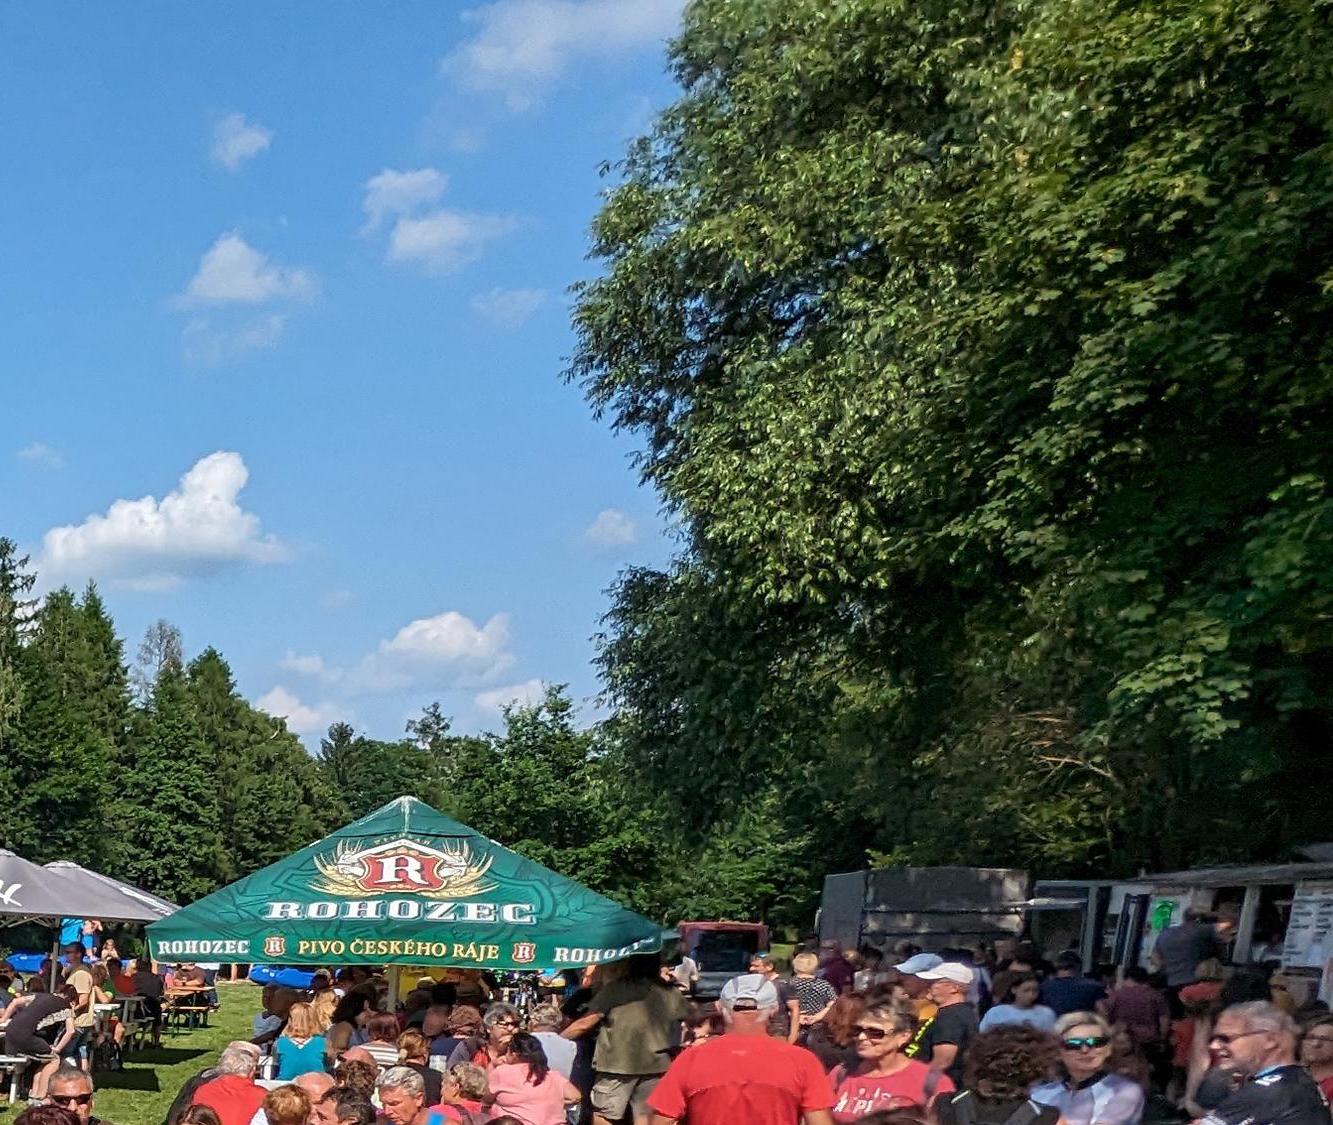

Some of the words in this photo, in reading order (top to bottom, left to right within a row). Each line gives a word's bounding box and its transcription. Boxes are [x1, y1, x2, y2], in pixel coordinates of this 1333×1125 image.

[374, 856, 429, 885] R
[266, 899, 536, 924] ROHOZEC
[157, 940, 250, 954] ROHOZEC
[298, 940, 345, 955] PIVO
[350, 937, 446, 957] ČESKÉHO
[452, 941, 500, 961] RÁJE
